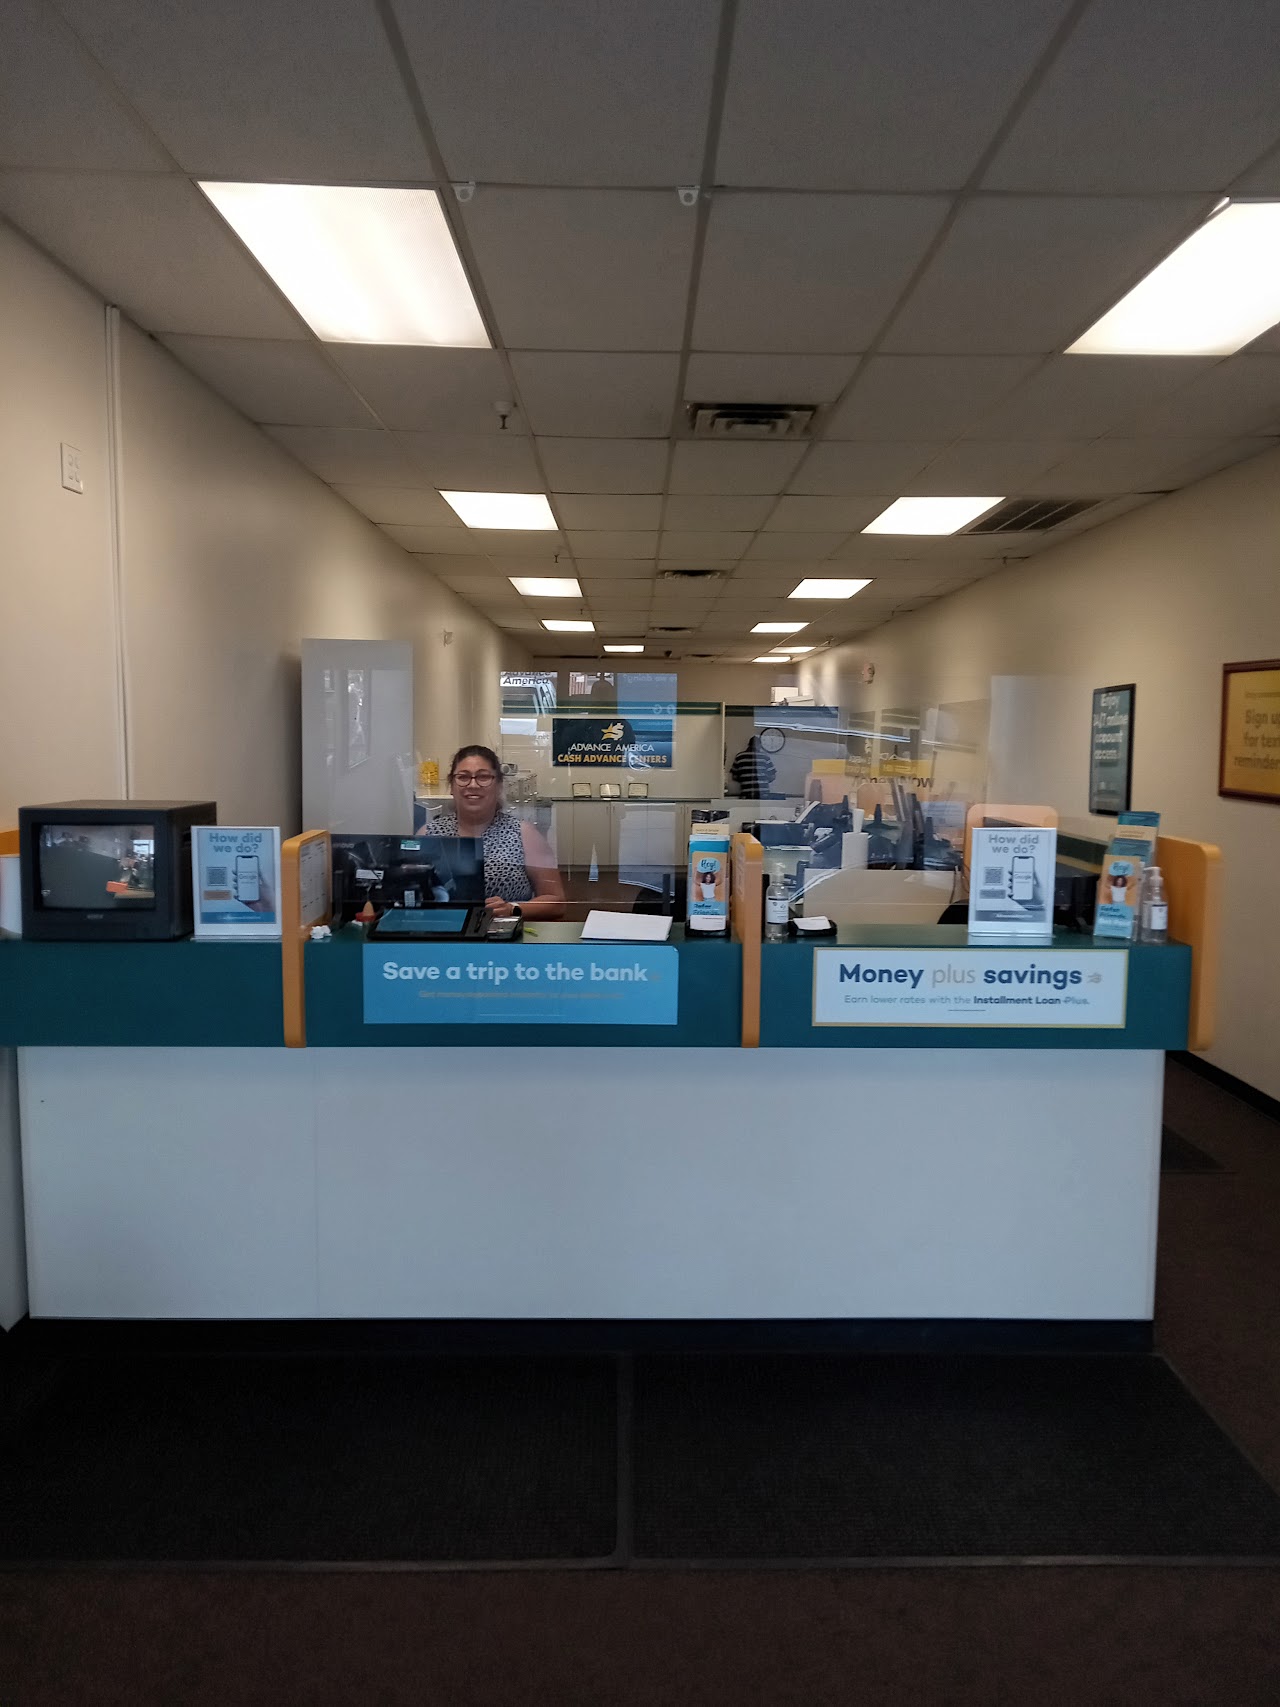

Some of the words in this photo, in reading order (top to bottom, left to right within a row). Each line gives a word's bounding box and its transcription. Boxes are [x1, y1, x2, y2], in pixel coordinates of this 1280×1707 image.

[1245, 708, 1269, 729] Sign
[570, 743, 611, 752] ADVANCE
[615, 743, 655, 752] AMERICA
[557, 754, 582, 763] CASH
[583, 754, 626, 763] ADVANCE
[209, 832, 238, 843] How
[241, 832, 263, 843] did
[988, 834, 1016, 844] How
[1019, 834, 1040, 844] did
[213, 844, 232, 853] we
[235, 842, 259, 853] do?
[1012, 844, 1036, 854] do?
[382, 961, 440, 980] Save
[445, 966, 461, 980] a
[466, 961, 509, 986] trip
[514, 962, 540, 980] to
[544, 962, 584, 981] the
[590, 963, 649, 982] bank
[838, 963, 924, 989] Money
[931, 964, 976, 989] plus
[983, 963, 1083, 990] savings
[844, 994, 869, 1004] Earn
[870, 995, 898, 1004] lower
[899, 995, 926, 1004] rates
[928, 995, 952, 1004] with
[953, 995, 971, 1004] the
[973, 995, 1033, 1005] Installment
[1035, 996, 1061, 1005] Loan
